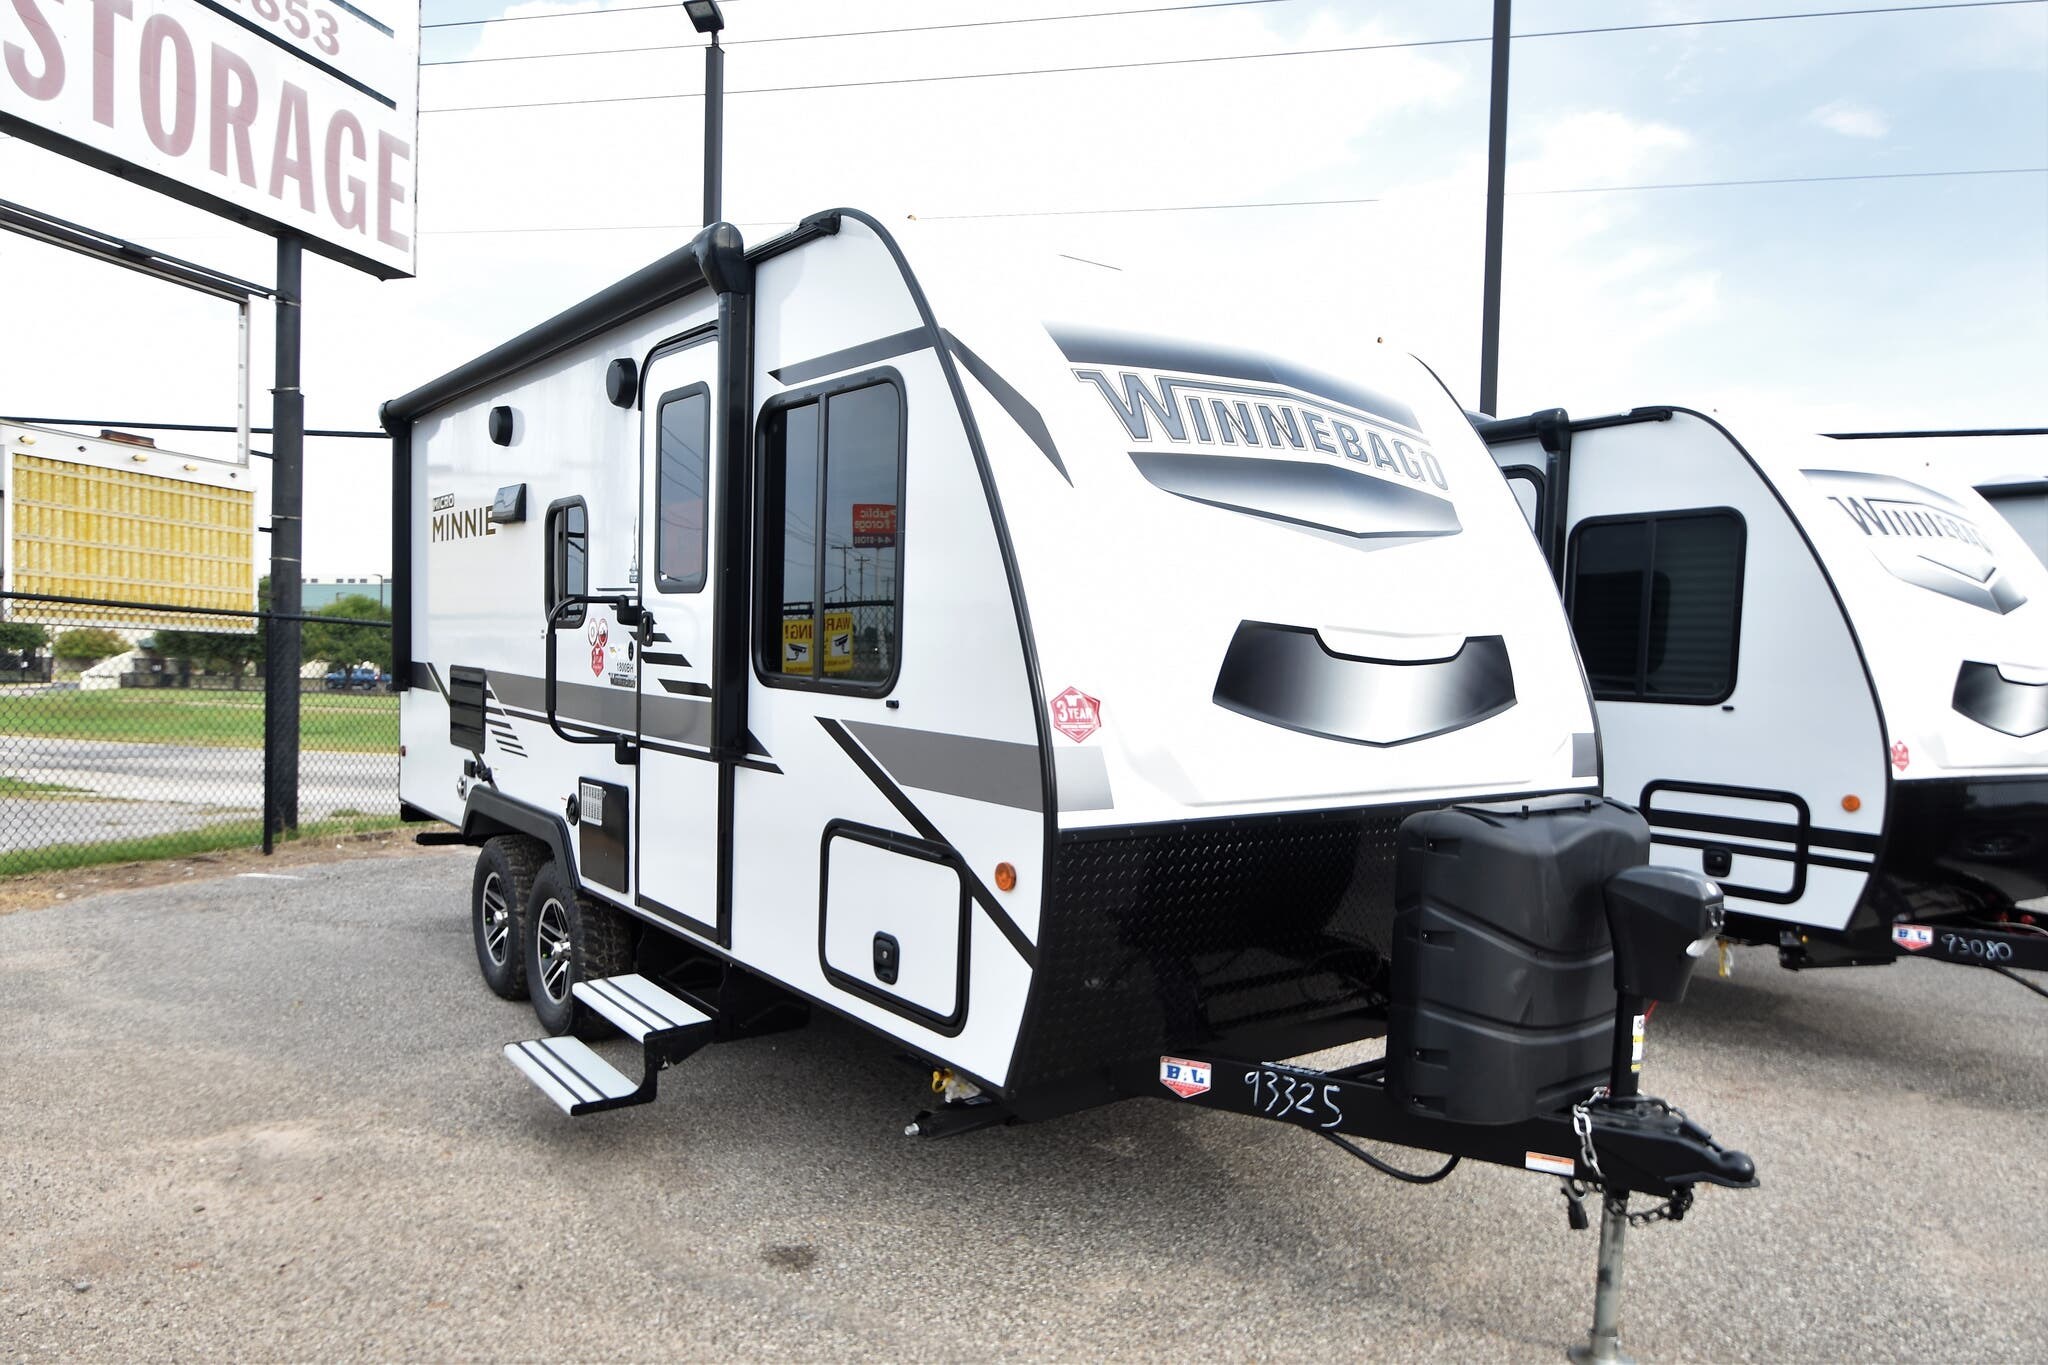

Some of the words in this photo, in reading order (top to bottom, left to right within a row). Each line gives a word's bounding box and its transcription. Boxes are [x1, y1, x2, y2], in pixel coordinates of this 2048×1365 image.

[3, 0, 411, 253] STORAGE
[1070, 367, 1449, 492] WINNEBAGO
[432, 505, 497, 543] MINNIE
[1243, 1070, 1343, 1128] 93325
